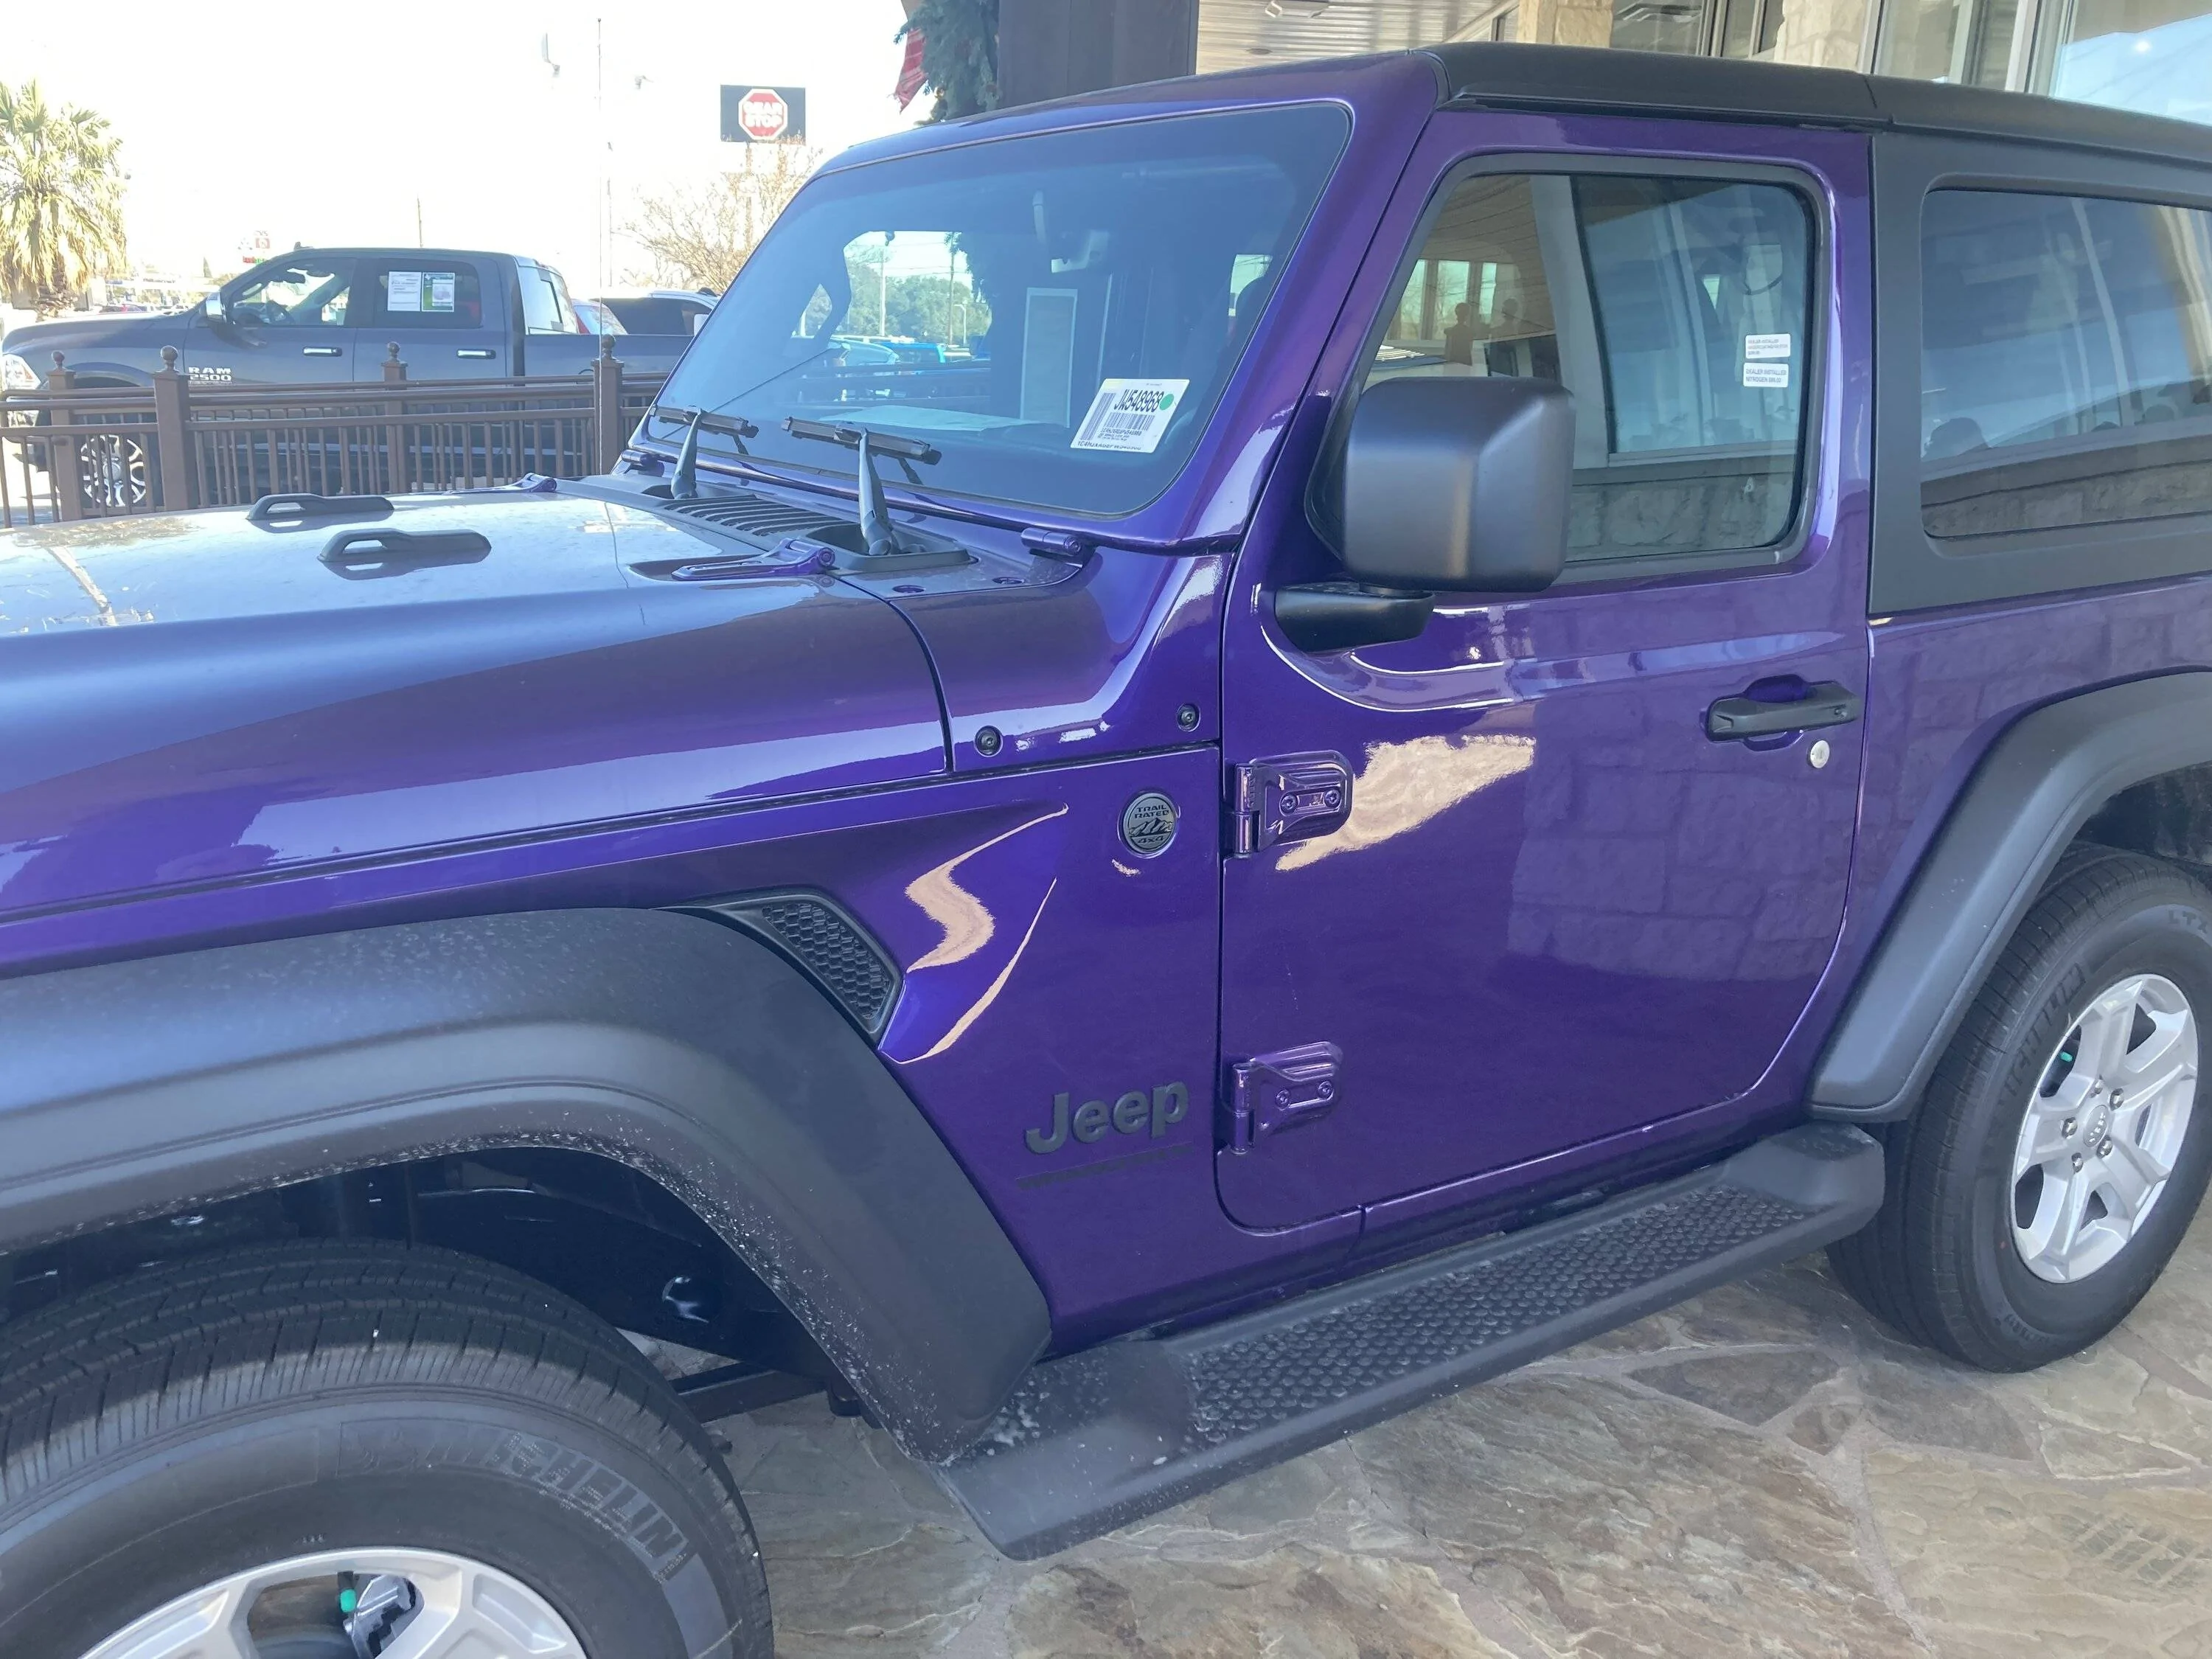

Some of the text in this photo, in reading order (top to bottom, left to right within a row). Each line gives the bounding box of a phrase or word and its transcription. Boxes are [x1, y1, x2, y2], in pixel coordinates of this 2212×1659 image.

[189, 366, 232, 375] RAM
[1136, 804, 1167, 813] TRAIL
[1134, 810, 1169, 819] RATED
[1024, 1081, 1189, 1155] Jeep
